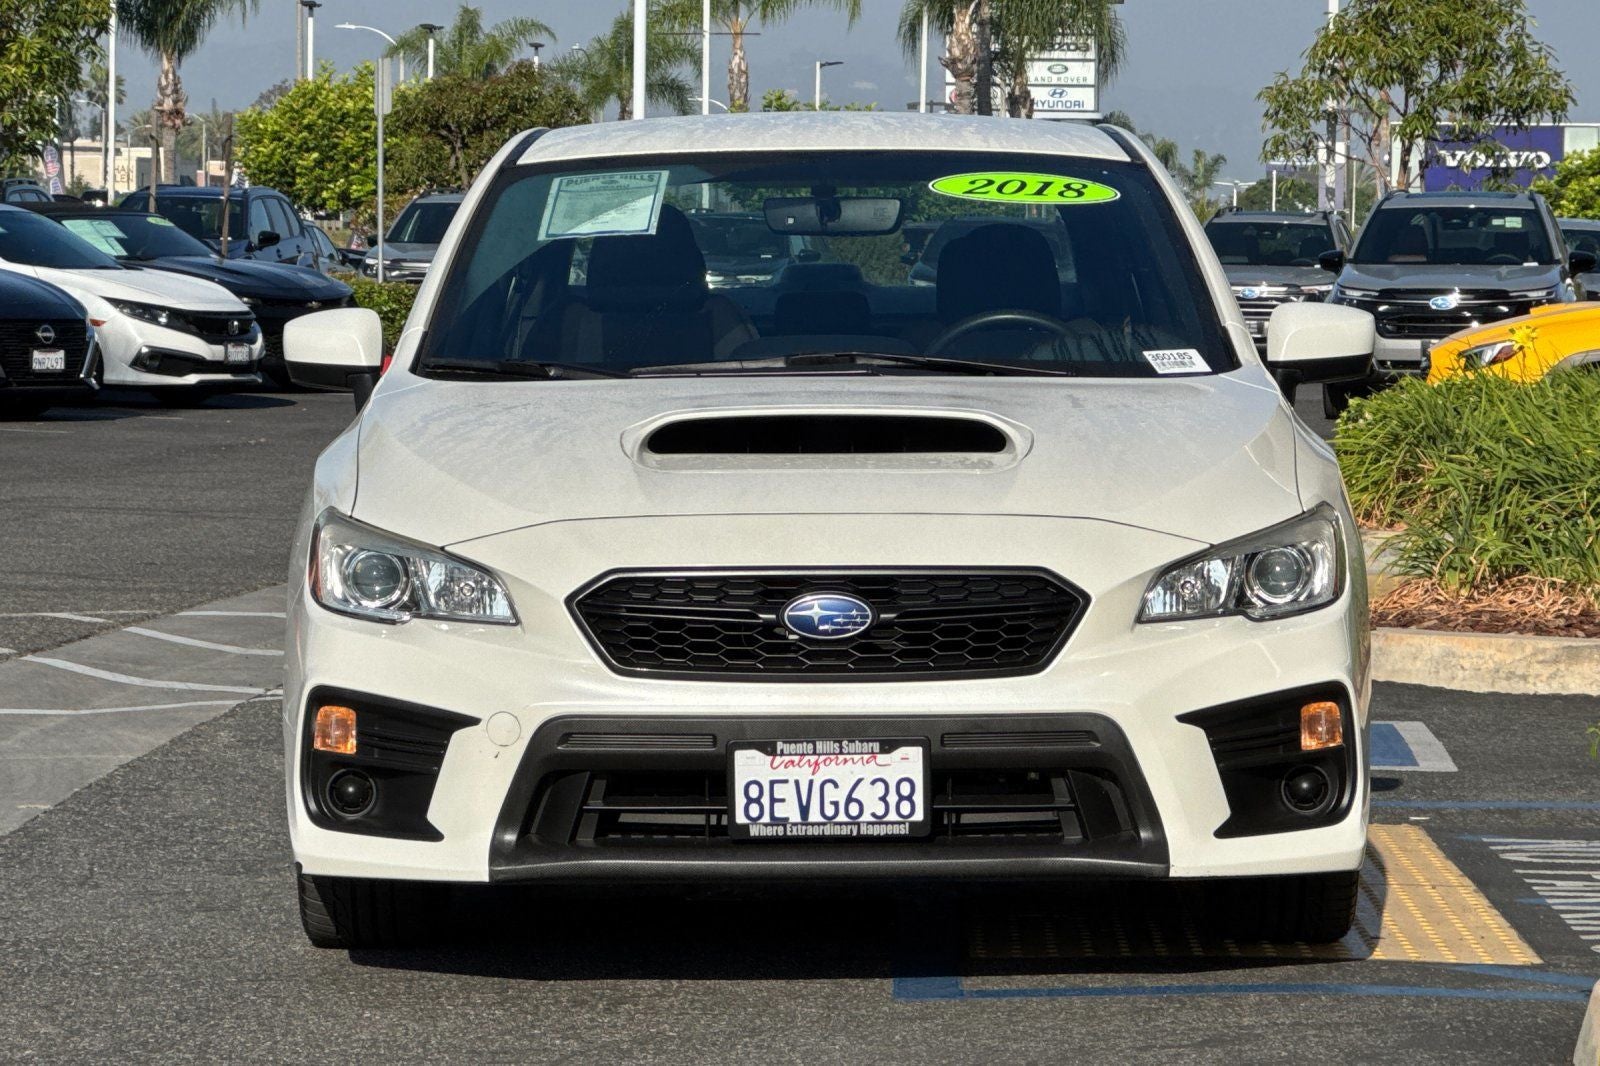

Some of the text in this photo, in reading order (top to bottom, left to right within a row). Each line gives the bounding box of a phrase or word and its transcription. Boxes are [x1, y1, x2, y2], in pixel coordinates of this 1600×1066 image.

[1034, 99, 1085, 109] HYUNDAI
[1438, 149, 1551, 169] VOLVO
[962, 178, 1089, 199] 2018
[1147, 351, 1193, 361] 360185
[776, 740, 880, 754] Puente Hills Subaru
[769, 753, 892, 776] California
[743, 776, 916, 822] 8EVG638
[749, 822, 910, 837] Where Extraordinary Happens!
